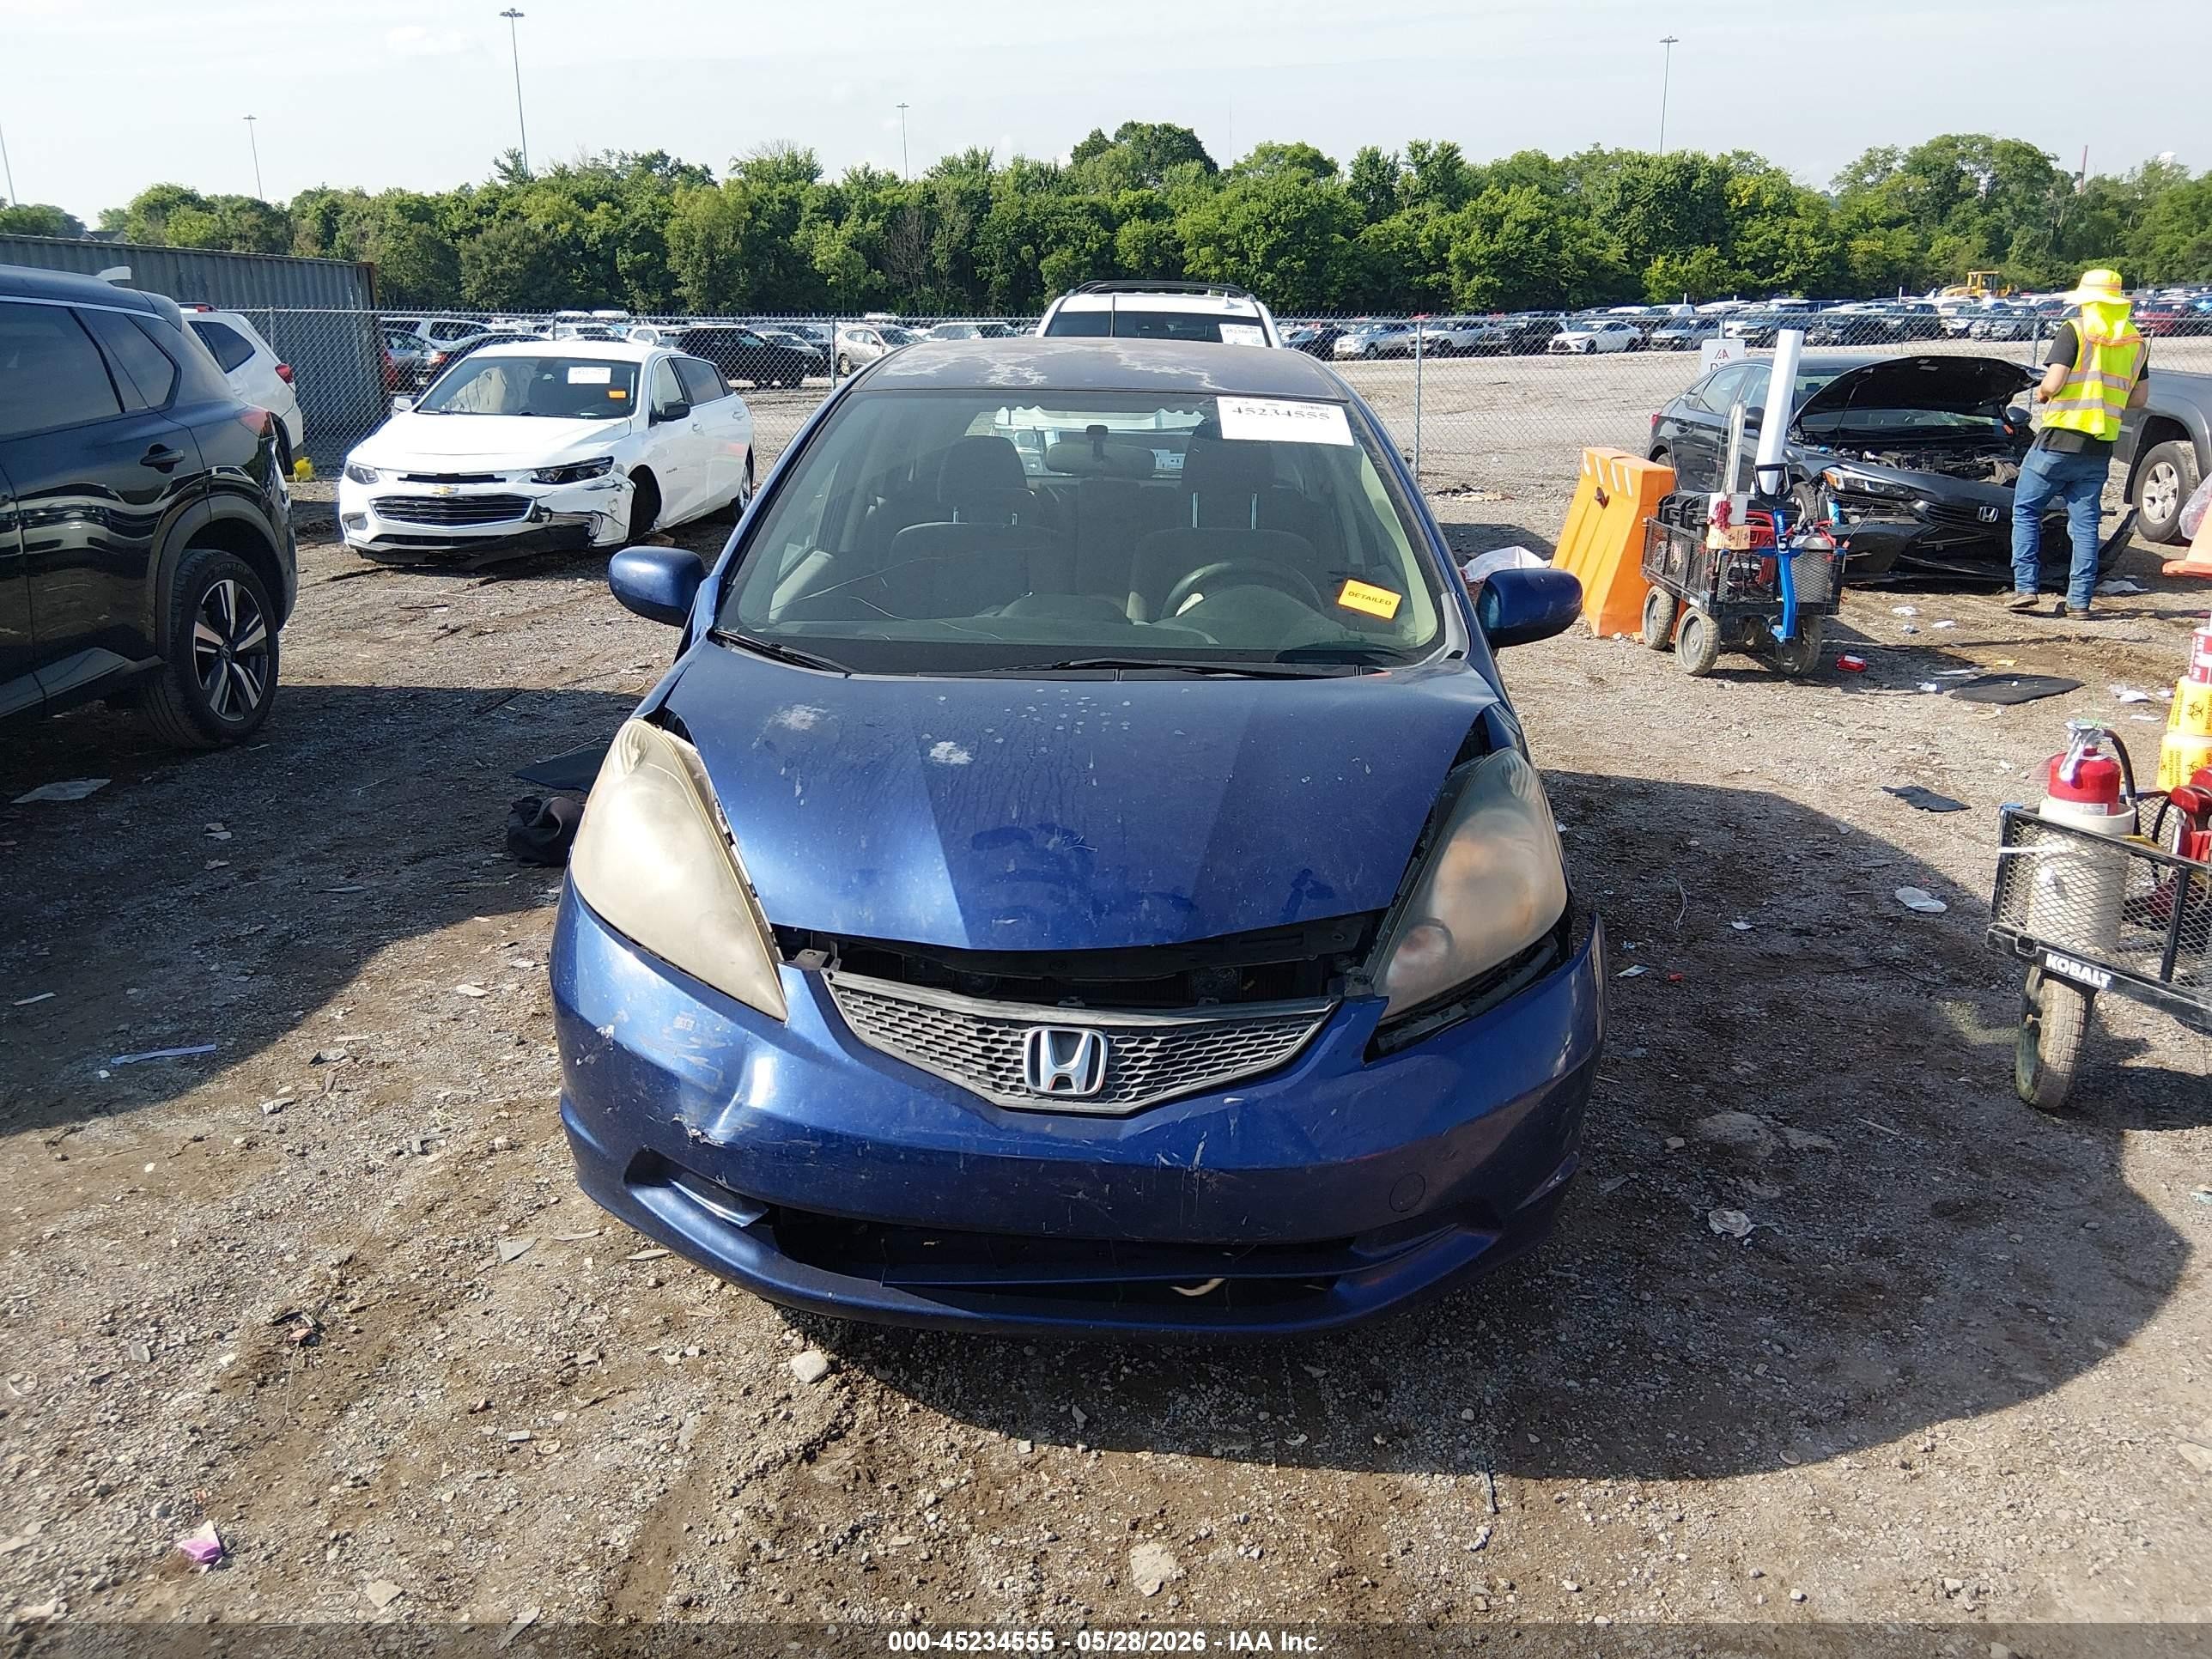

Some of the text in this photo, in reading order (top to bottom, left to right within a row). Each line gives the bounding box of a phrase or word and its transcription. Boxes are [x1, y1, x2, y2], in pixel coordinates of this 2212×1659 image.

[1231, 406, 1330, 421] 45234555
[1347, 591, 1392, 605] DETAILED
[2045, 952, 2112, 988] KOBALT
